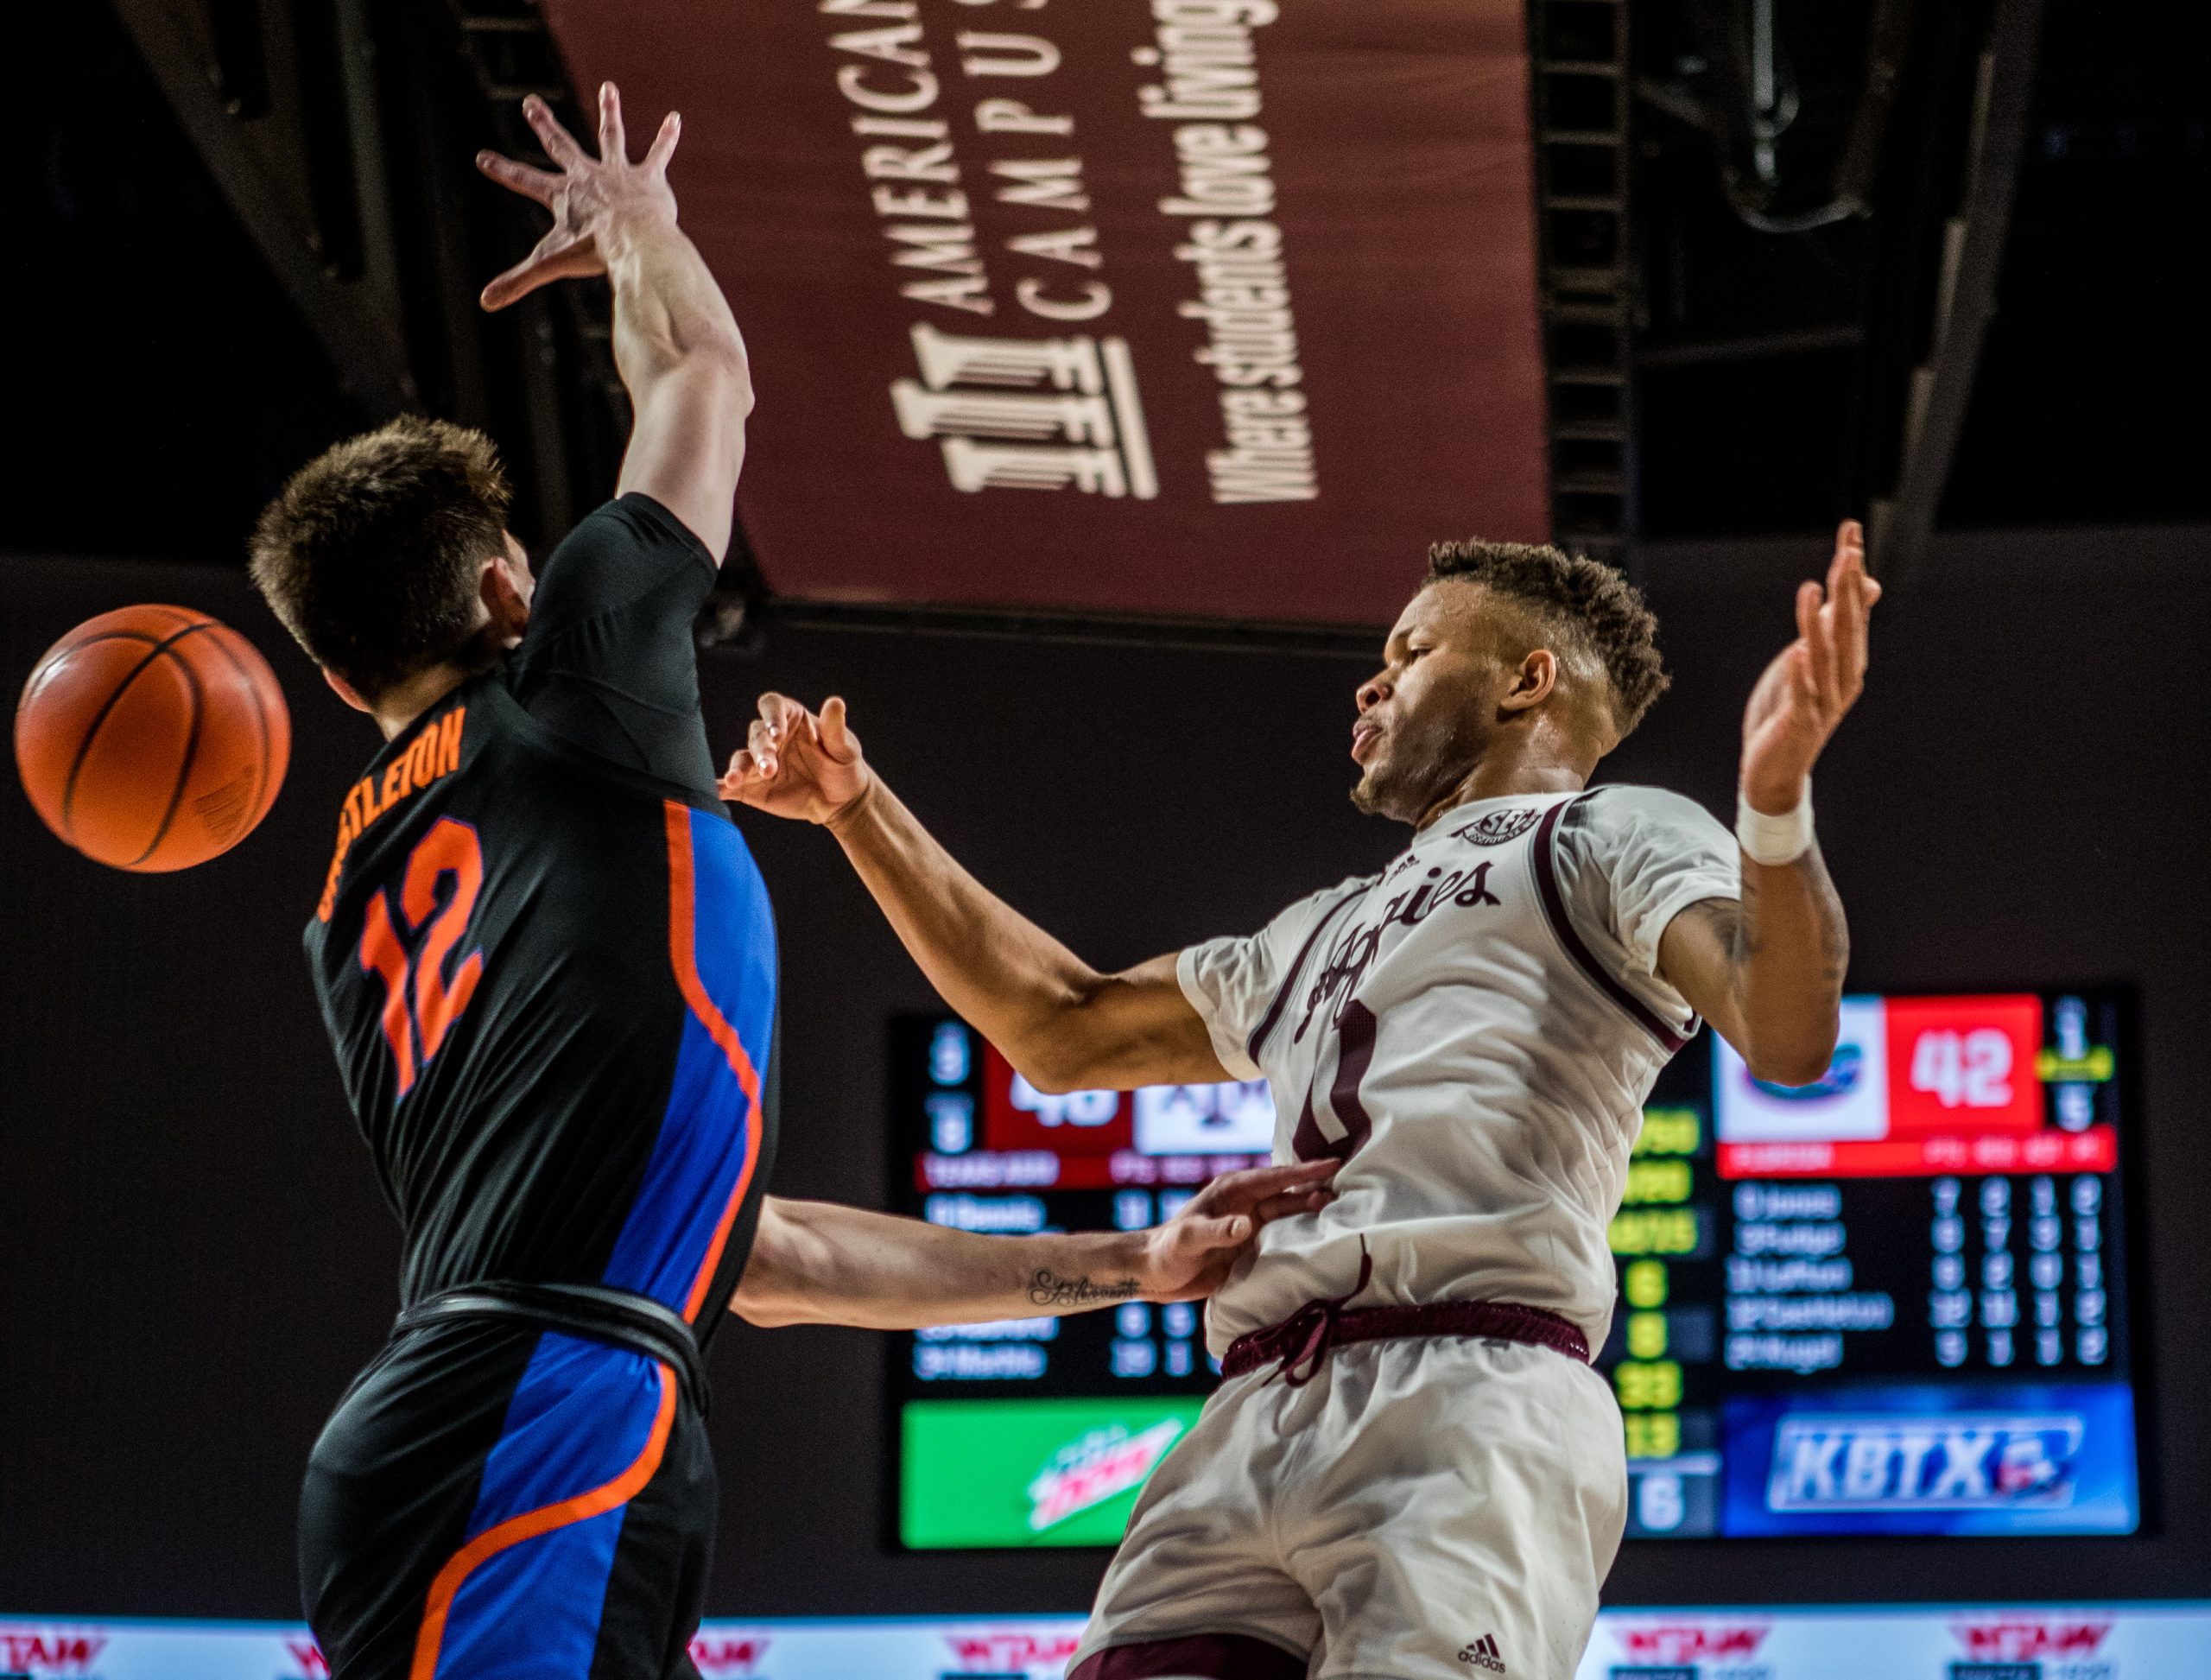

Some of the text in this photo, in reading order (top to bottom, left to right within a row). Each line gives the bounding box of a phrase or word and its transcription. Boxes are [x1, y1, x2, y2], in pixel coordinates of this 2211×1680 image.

[1131, 0, 1319, 504] Where students love living
[358, 815, 484, 1102] 12
[1911, 1028, 2013, 1107] 42
[1791, 1436, 1994, 1499] KBTX
[1457, 1651, 1506, 1674] adidas
